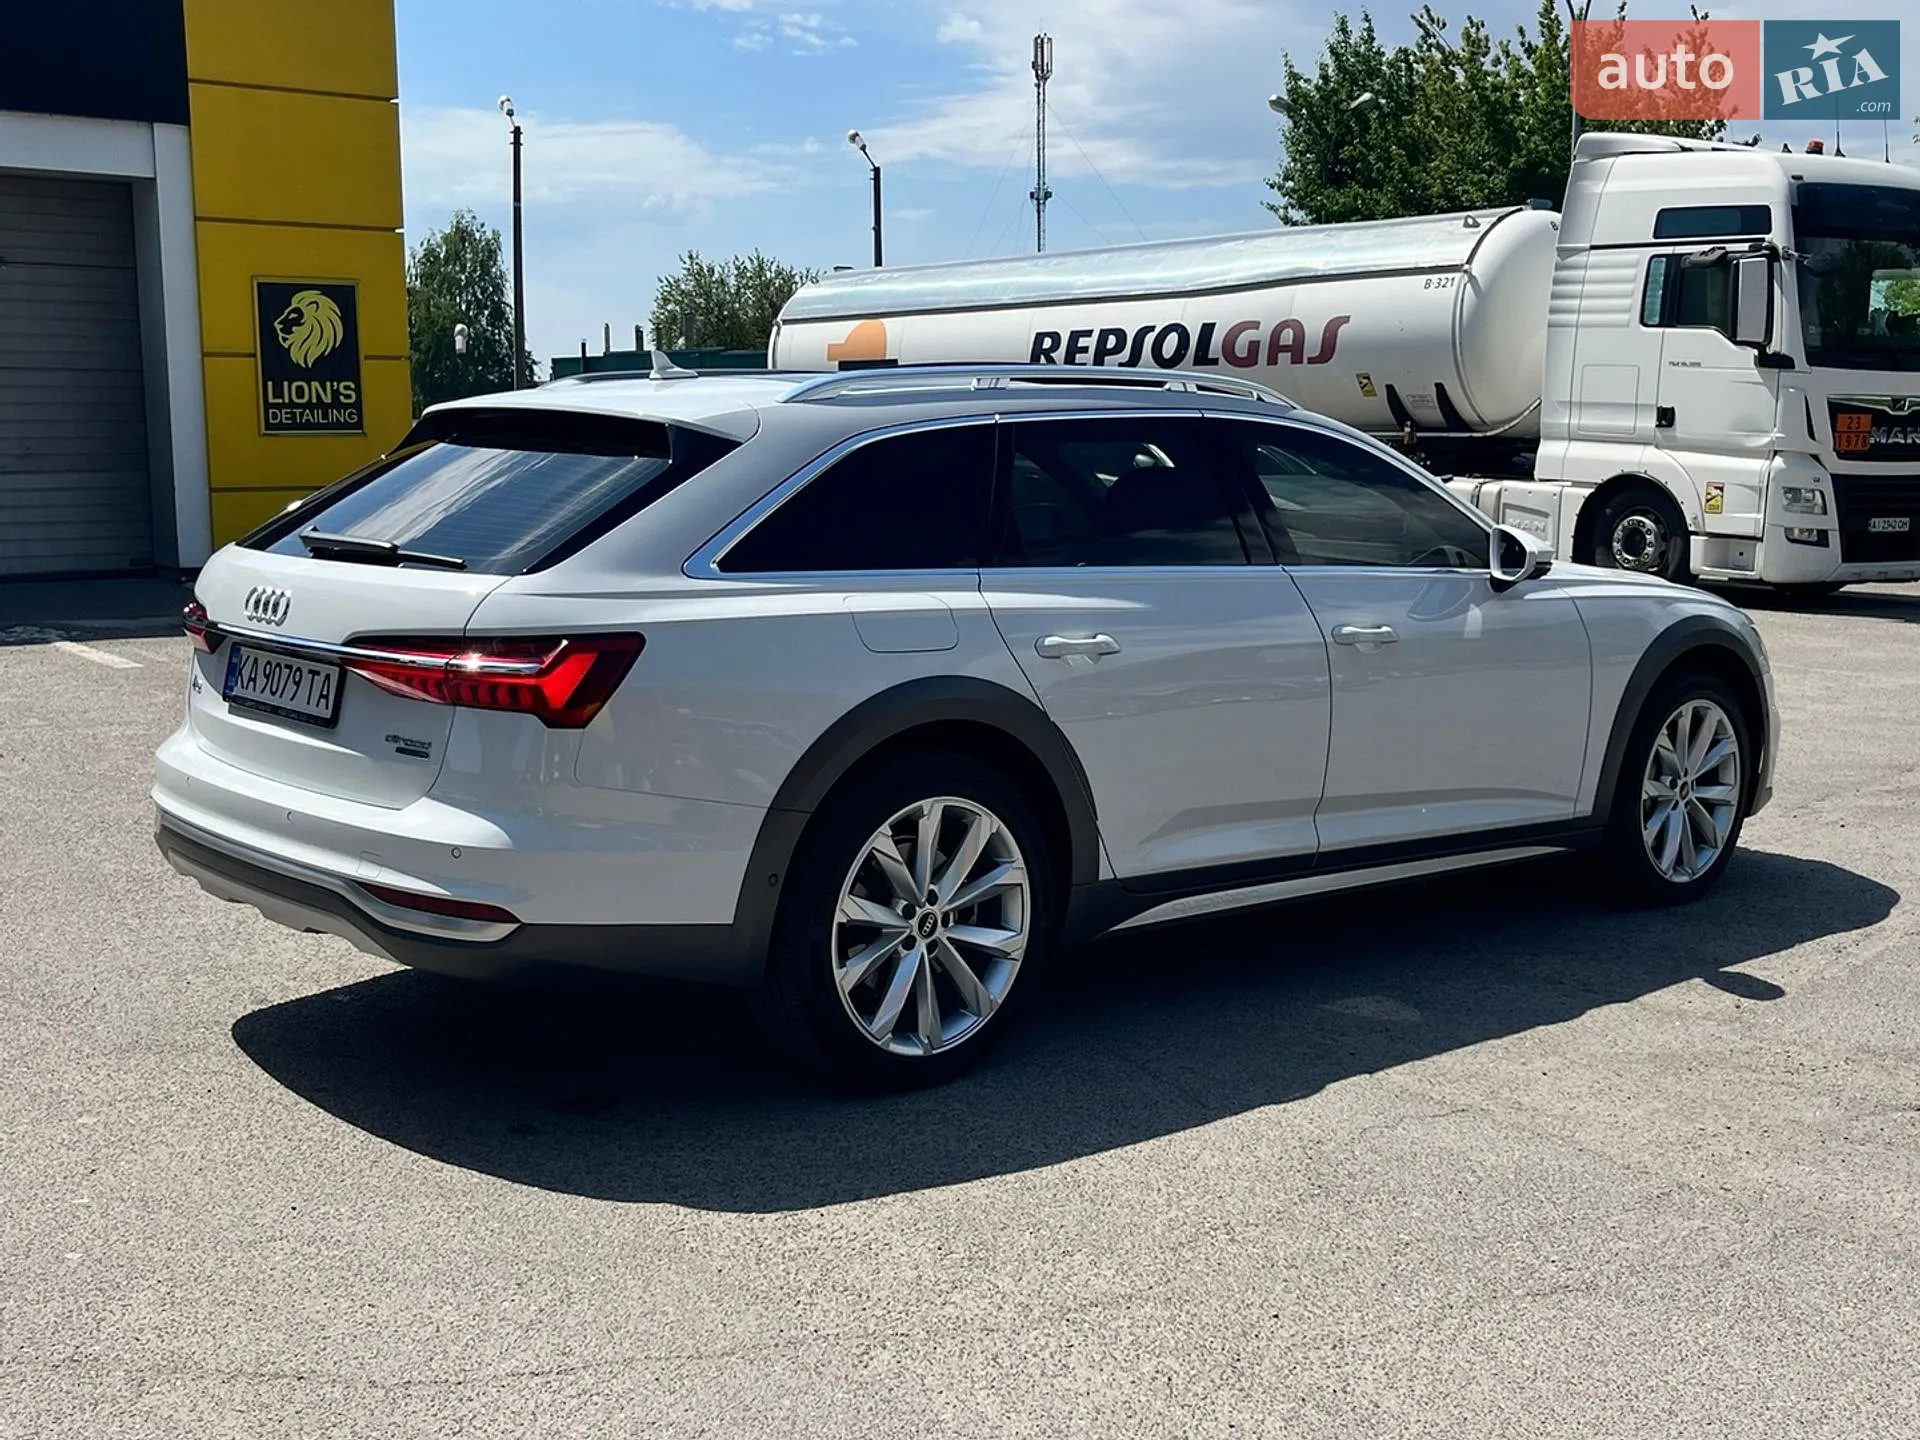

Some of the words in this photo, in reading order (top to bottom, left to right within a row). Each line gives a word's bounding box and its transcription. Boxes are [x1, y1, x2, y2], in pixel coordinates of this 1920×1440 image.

[266, 380, 357, 404] LION'S
[268, 408, 359, 424] DETAILING
[1846, 415, 1862, 431] 23
[235, 653, 259, 693] KA
[260, 660, 303, 702] 9079
[306, 668, 331, 711] TA
